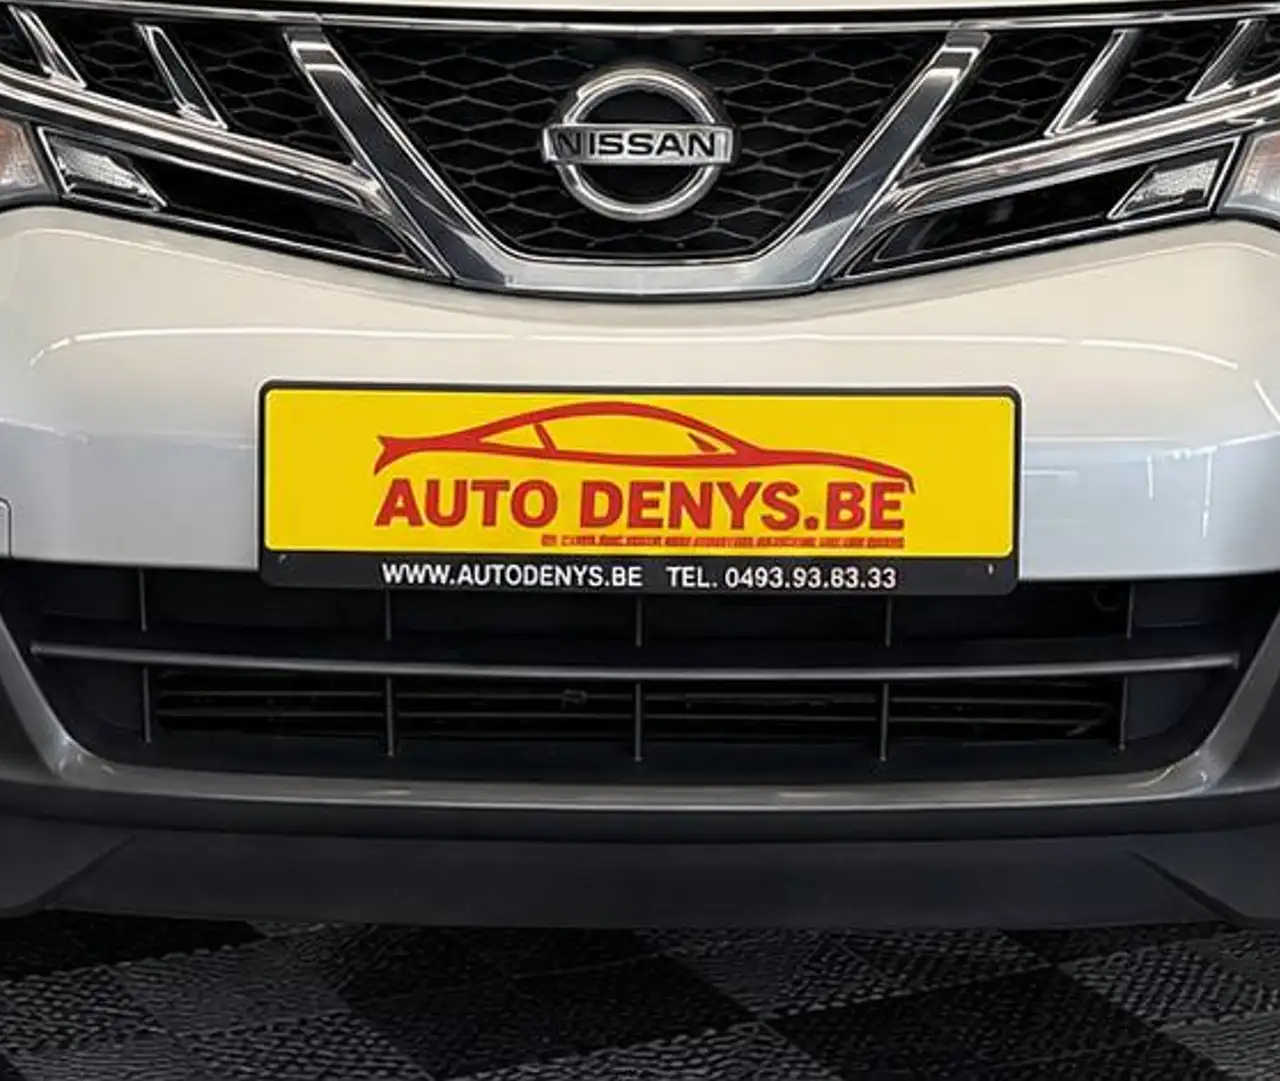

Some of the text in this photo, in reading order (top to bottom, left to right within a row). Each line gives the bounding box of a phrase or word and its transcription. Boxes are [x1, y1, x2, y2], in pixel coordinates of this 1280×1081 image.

[556, 132, 715, 156] NISSAN
[374, 478, 905, 531] AUTO DENYS.BE
[382, 562, 897, 589] WWW.AUTODENYS.BE TEL. 0493.93.83.33
